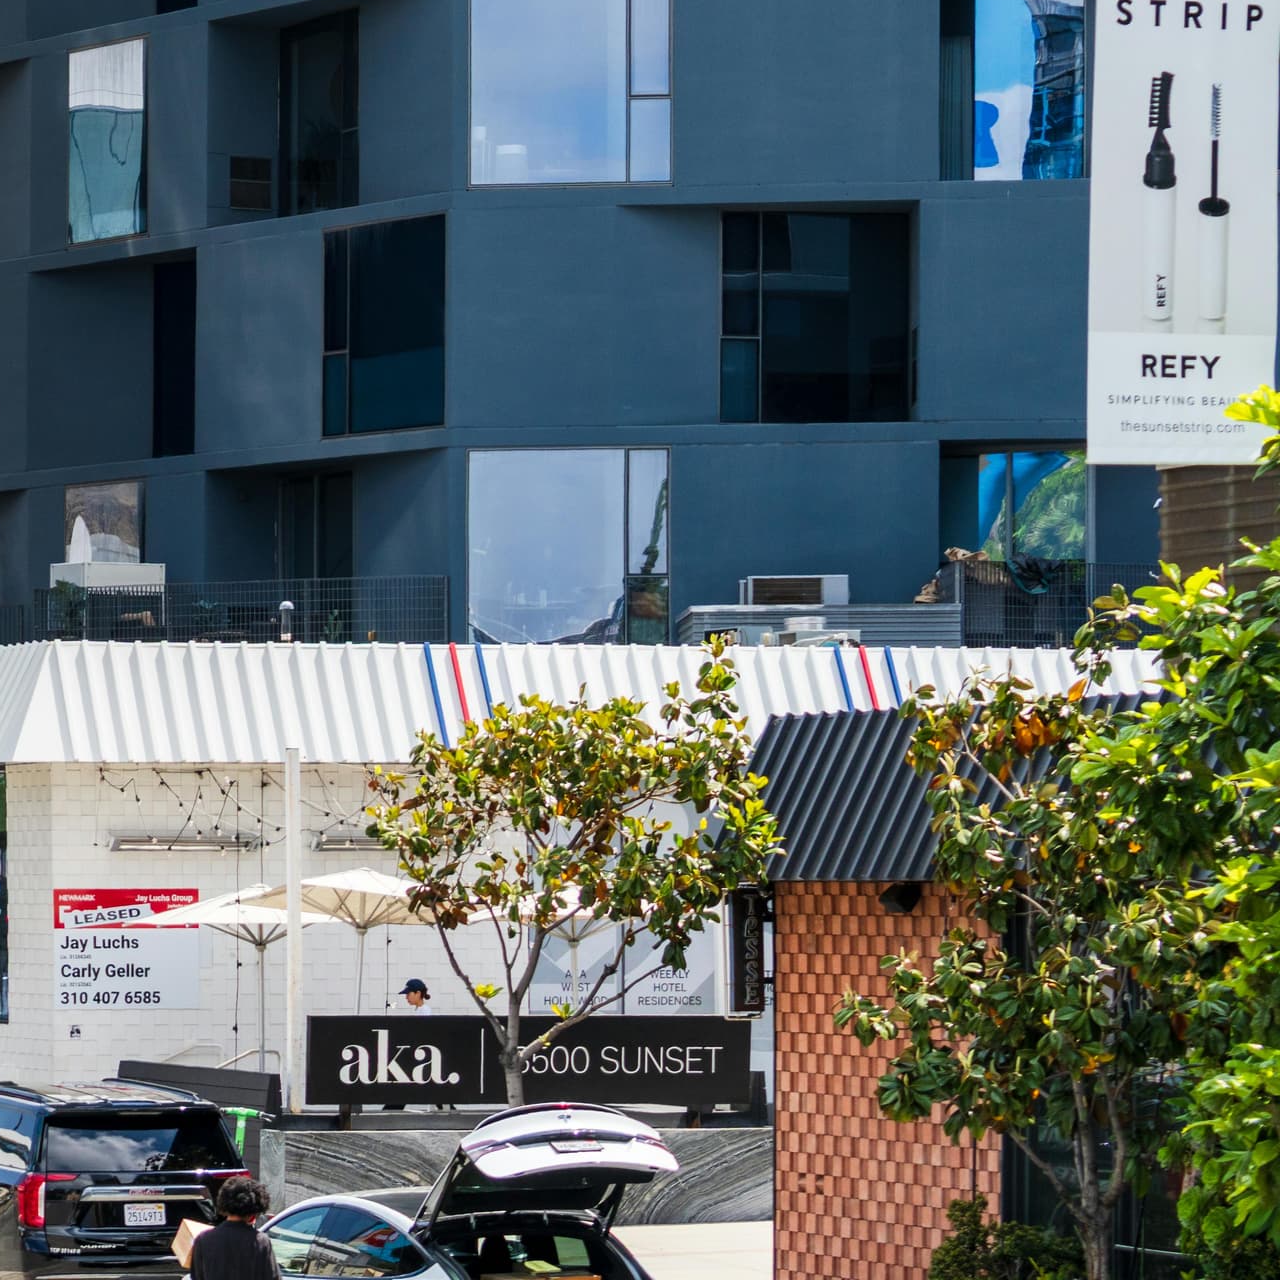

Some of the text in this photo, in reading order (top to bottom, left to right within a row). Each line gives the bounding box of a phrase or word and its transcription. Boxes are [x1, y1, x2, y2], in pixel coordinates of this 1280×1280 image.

[1156, 274, 1166, 308] REFY
[1141, 353, 1221, 380] REFY
[1107, 394, 1196, 406] SIMPLIFYING
[1120, 420, 1246, 435] thesunsetstrip.com
[58, 894, 193, 903] NEWMARK Jay Luchs Group
[74, 907, 141, 925] LEASED
[60, 935, 139, 952] Jay Luchs
[61, 963, 151, 981] Carly Geller
[564, 970, 587, 979] AA
[649, 970, 690, 979] WEEKLY
[561, 983, 591, 992] WST
[653, 983, 687, 992] HOTEL
[61, 991, 161, 1004] 310 407 6585
[638, 996, 702, 1006] RESIDENCES
[339, 1029, 461, 1085] aka.
[600, 1046, 724, 1074] SUNSET
